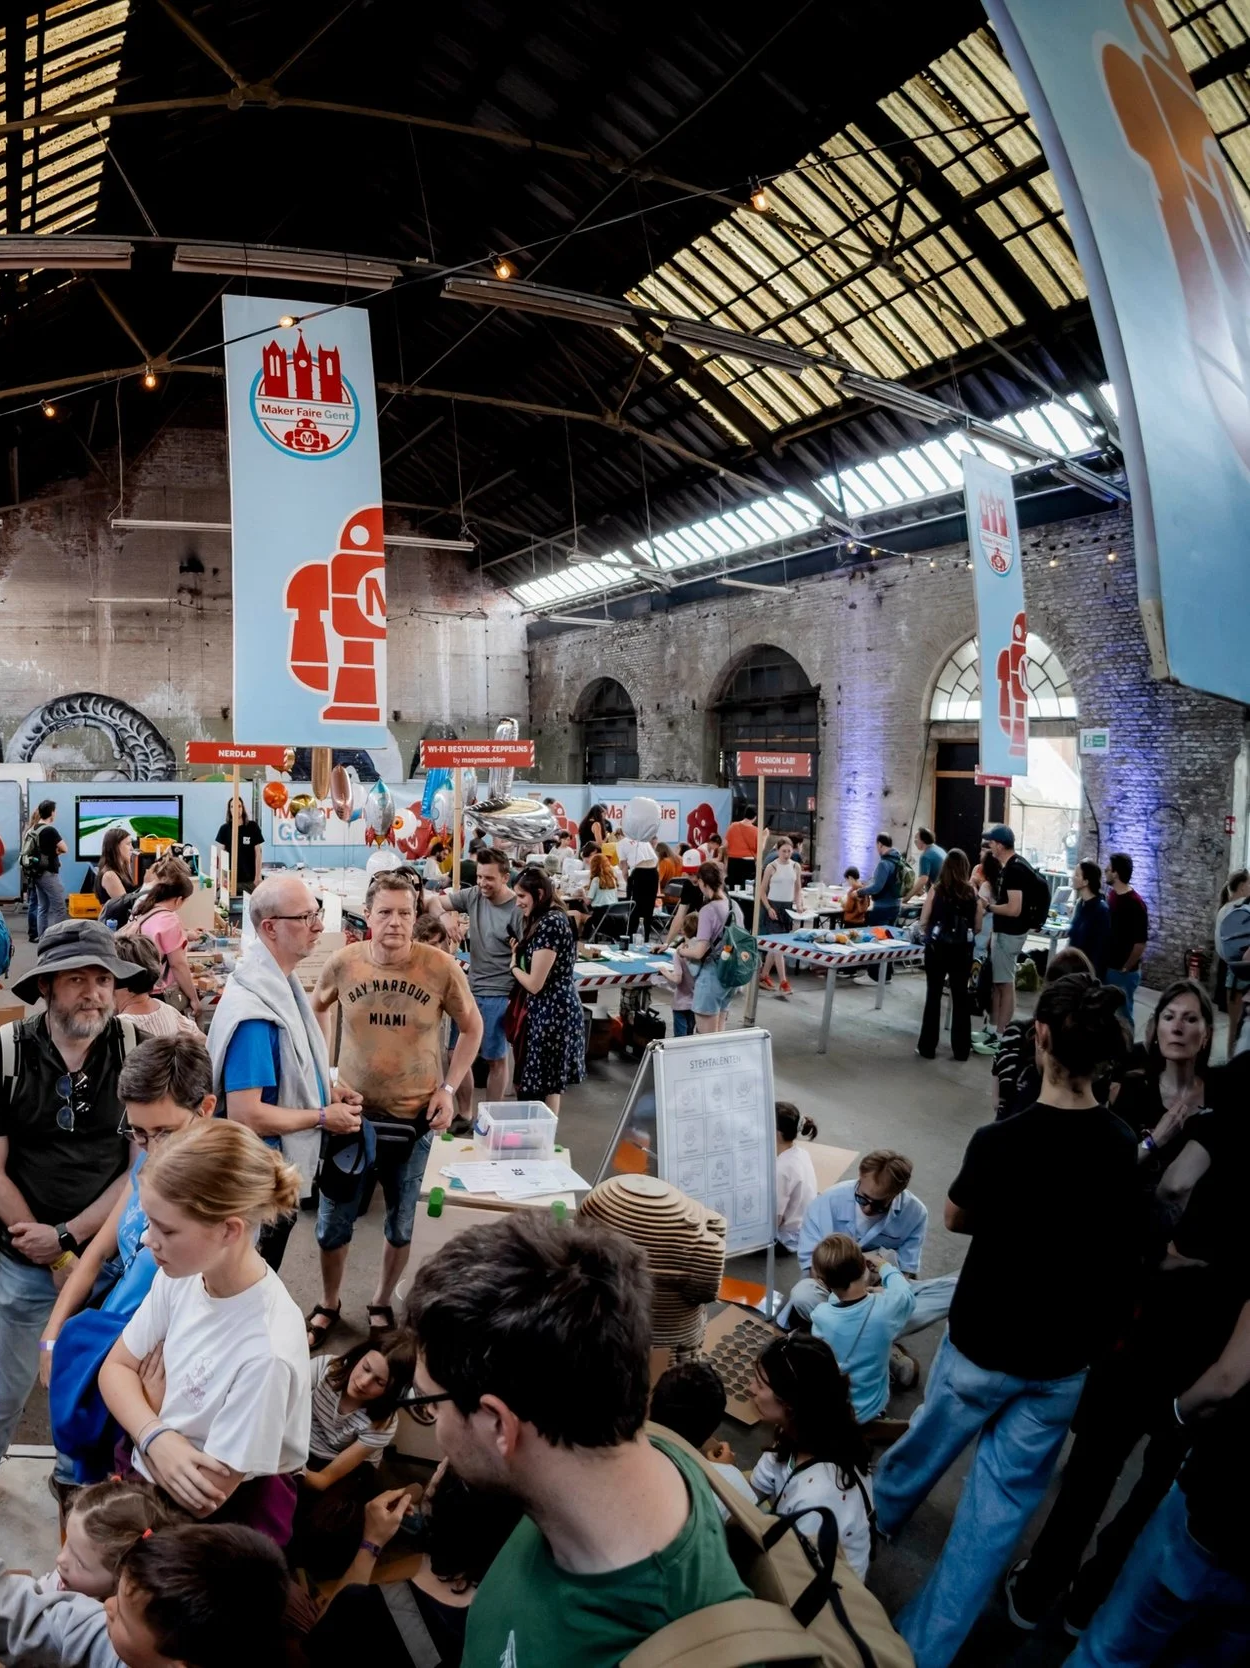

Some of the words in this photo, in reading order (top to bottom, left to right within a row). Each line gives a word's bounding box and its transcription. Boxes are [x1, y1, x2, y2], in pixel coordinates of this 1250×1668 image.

[261, 404, 294, 416] Maker
[297, 407, 322, 418] Faire
[324, 410, 350, 420] Gent
[218, 749, 257, 758] NERDLAB
[428, 745, 447, 753] WI-FI
[448, 745, 490, 753] BESTUURDE
[491, 745, 528, 753] ZEPPELINS
[754, 756, 781, 764] FASHION
[348, 982, 367, 1003] BAY
[372, 979, 431, 1006] HARBOUR
[369, 1013, 406, 1026] MIAMI
